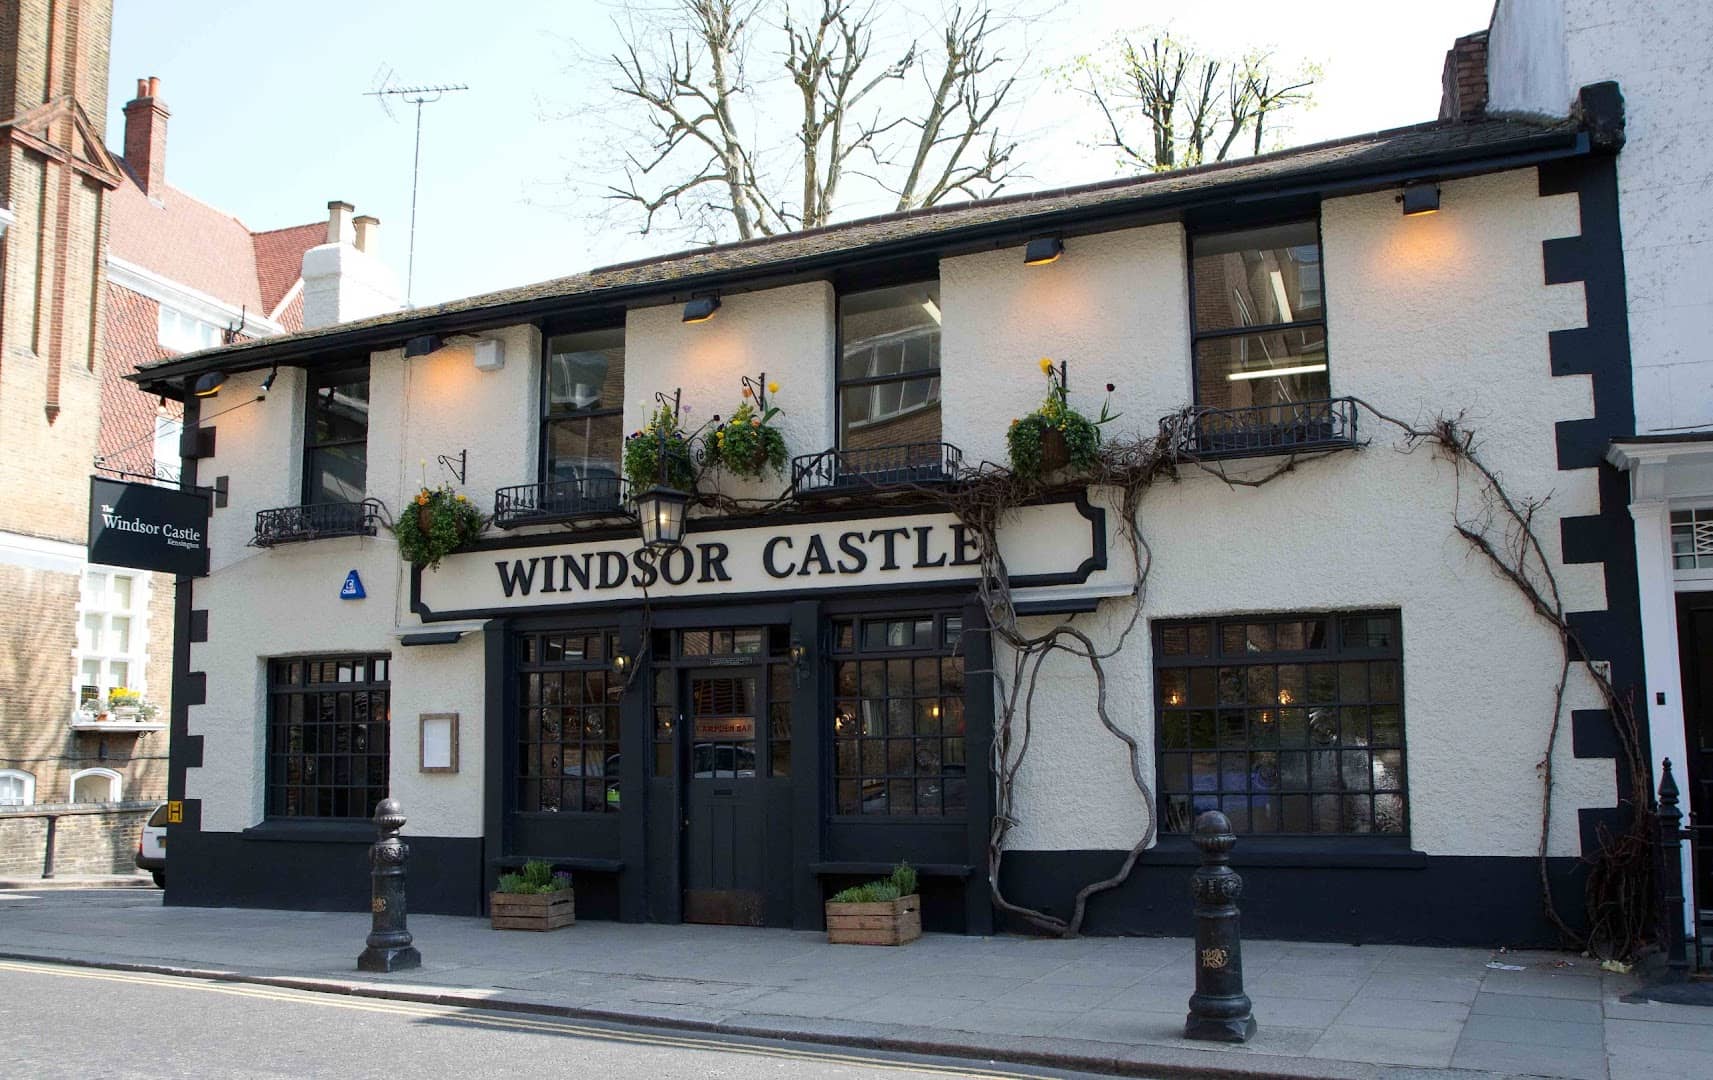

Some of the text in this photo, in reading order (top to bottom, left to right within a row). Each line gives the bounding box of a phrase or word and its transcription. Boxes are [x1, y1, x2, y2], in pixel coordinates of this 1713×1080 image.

[101, 504, 114, 513] The
[102, 514, 200, 541] Windsor Castle
[495, 524, 982, 597] WINDSOR CASTLE
[170, 802, 181, 821] H
